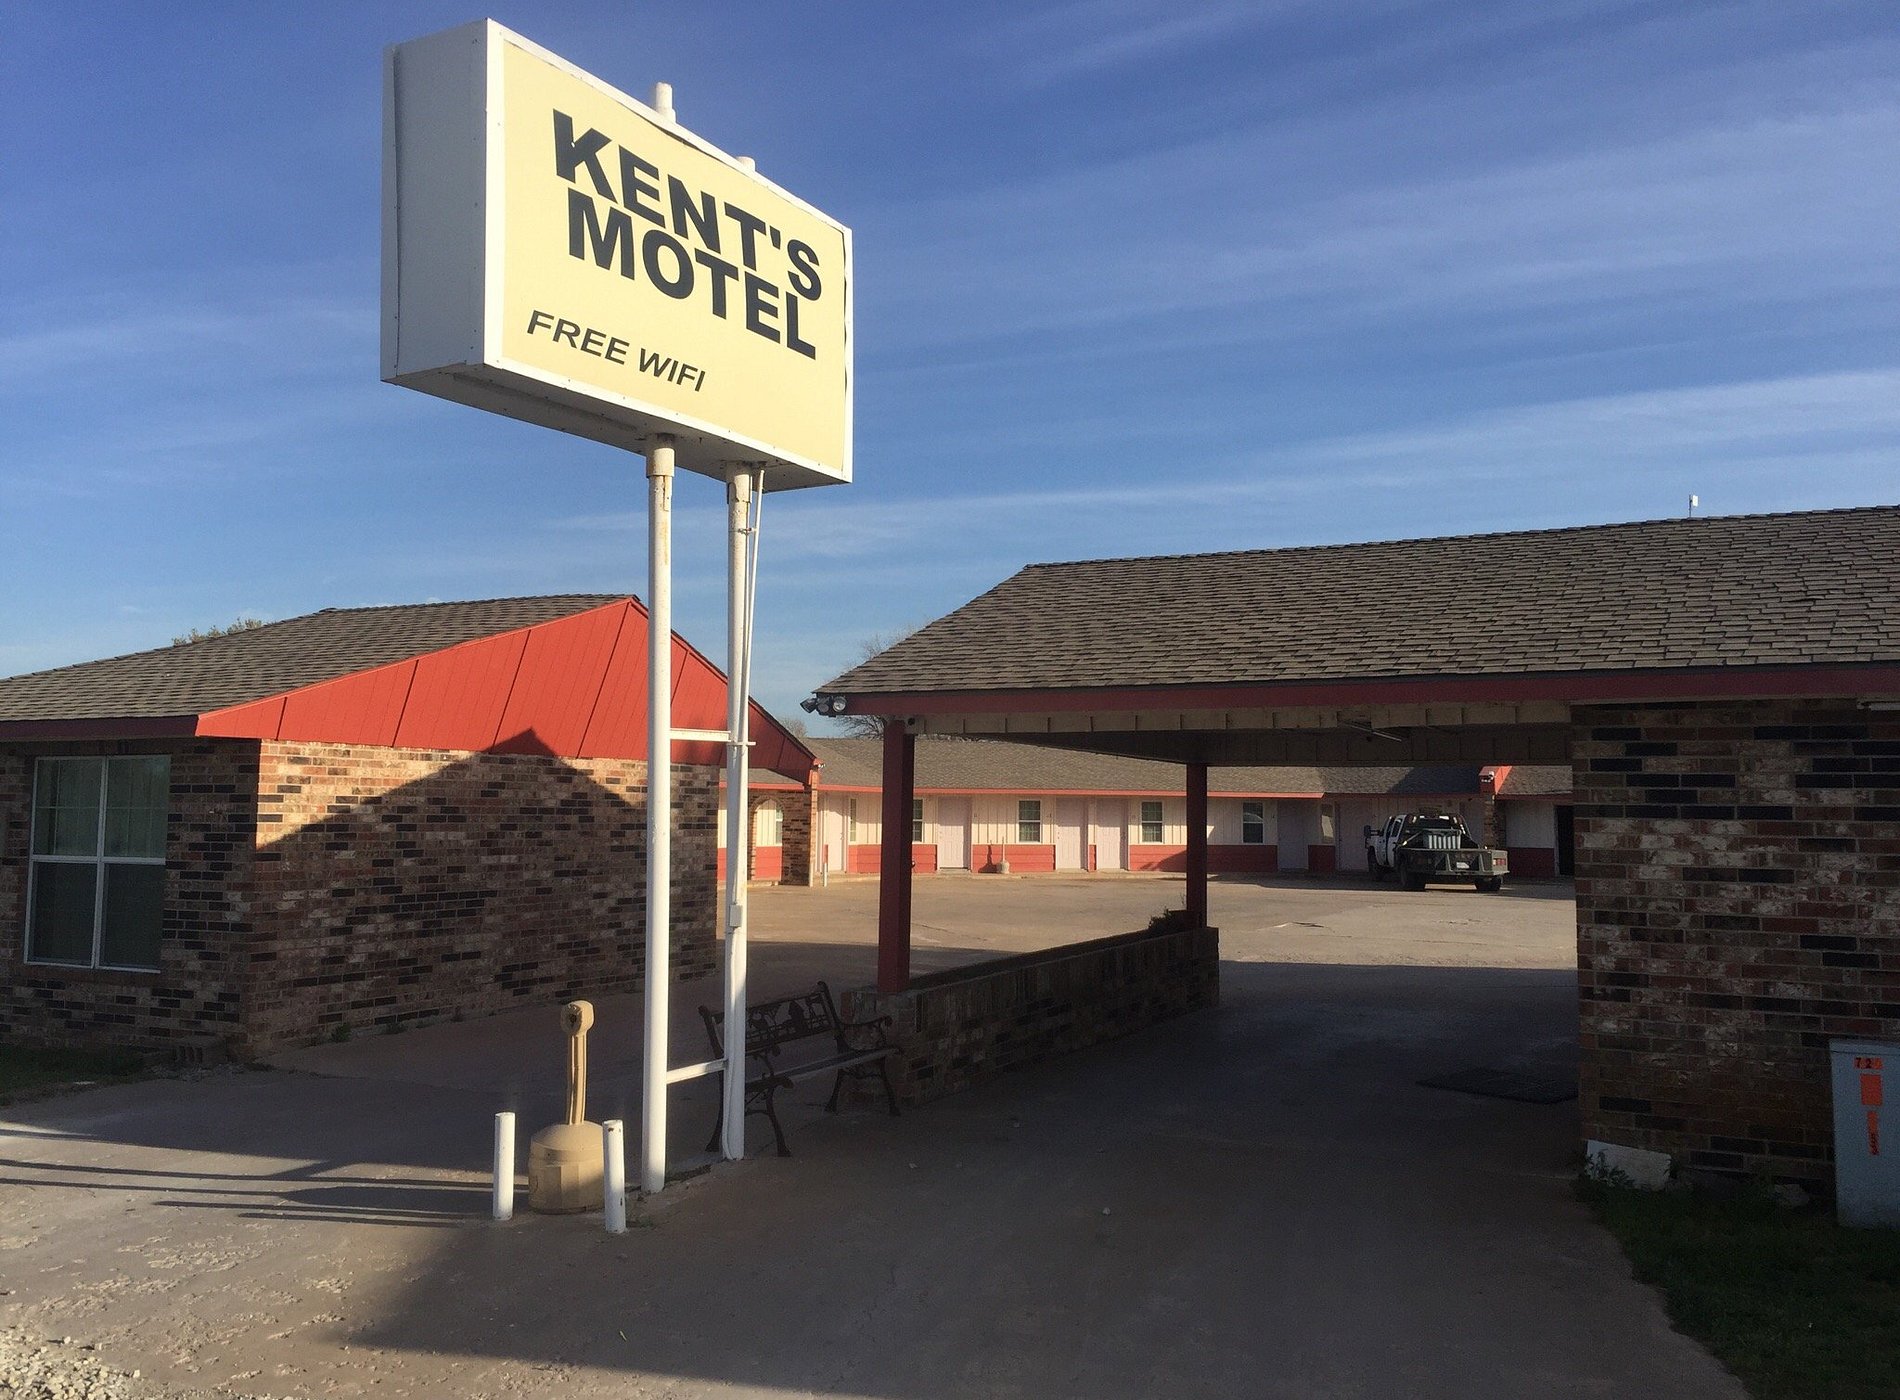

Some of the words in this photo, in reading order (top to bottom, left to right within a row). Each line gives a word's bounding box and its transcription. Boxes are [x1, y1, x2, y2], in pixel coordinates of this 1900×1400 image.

[553, 108, 822, 301] KENT'S
[567, 187, 816, 361] MOTEL
[527, 310, 630, 365] FREE
[639, 348, 706, 392] WIFI
